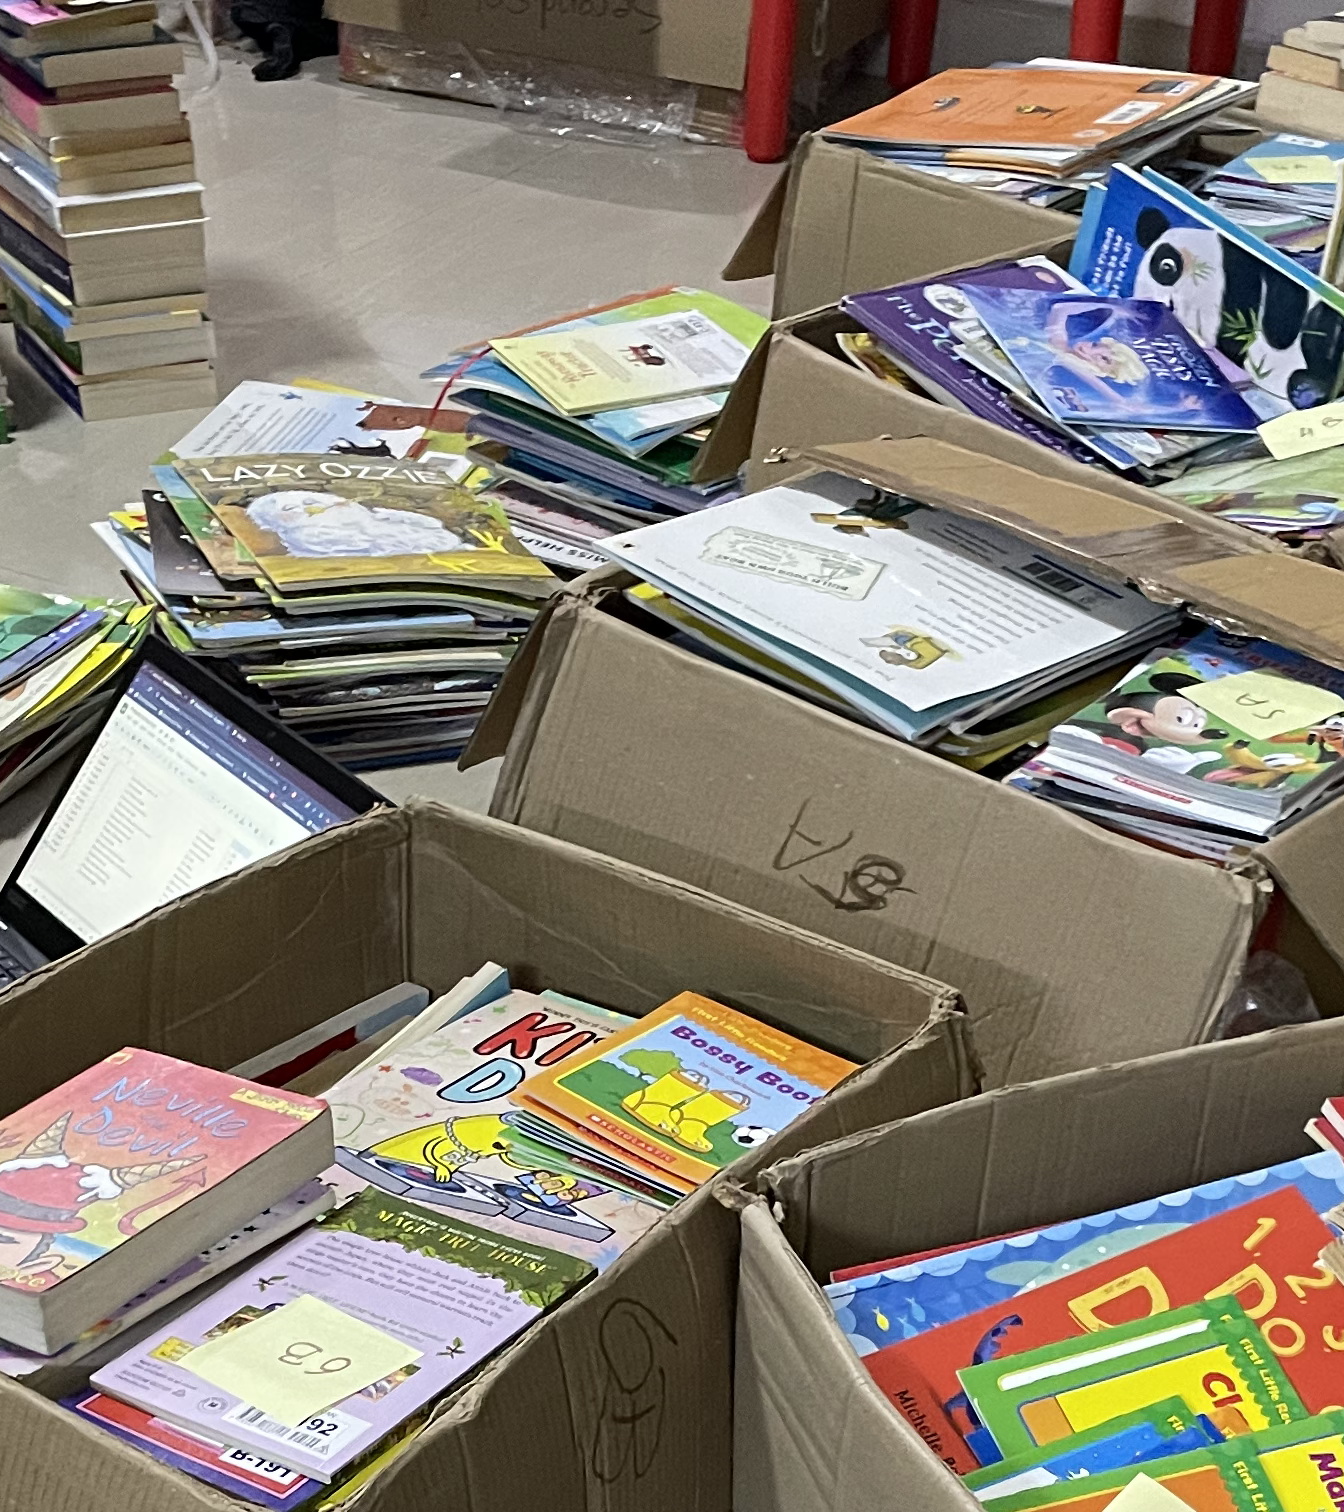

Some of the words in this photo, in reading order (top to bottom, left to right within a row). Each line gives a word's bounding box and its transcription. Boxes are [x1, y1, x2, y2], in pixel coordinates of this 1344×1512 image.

[201, 463, 308, 484] LAZY
[319, 462, 450, 486] OZZIE
[566, 548, 609, 564] MISS
[669, 1025, 755, 1075] Bossy
[72, 1105, 200, 1157] Devil
[90, 1076, 249, 1139] Neville
[374, 1209, 433, 1238] MAGIC
[438, 1231, 482, 1253] TREE
[487, 1244, 549, 1275] HOUSE
[277, 1341, 353, 1376] 6B
[1238, 1337, 1262, 1367] First
[1254, 1364, 1278, 1403] Little
[892, 1388, 947, 1459] Michelle
[1166, 1413, 1186, 1435] Fir
[1232, 1460, 1259, 1496] First
